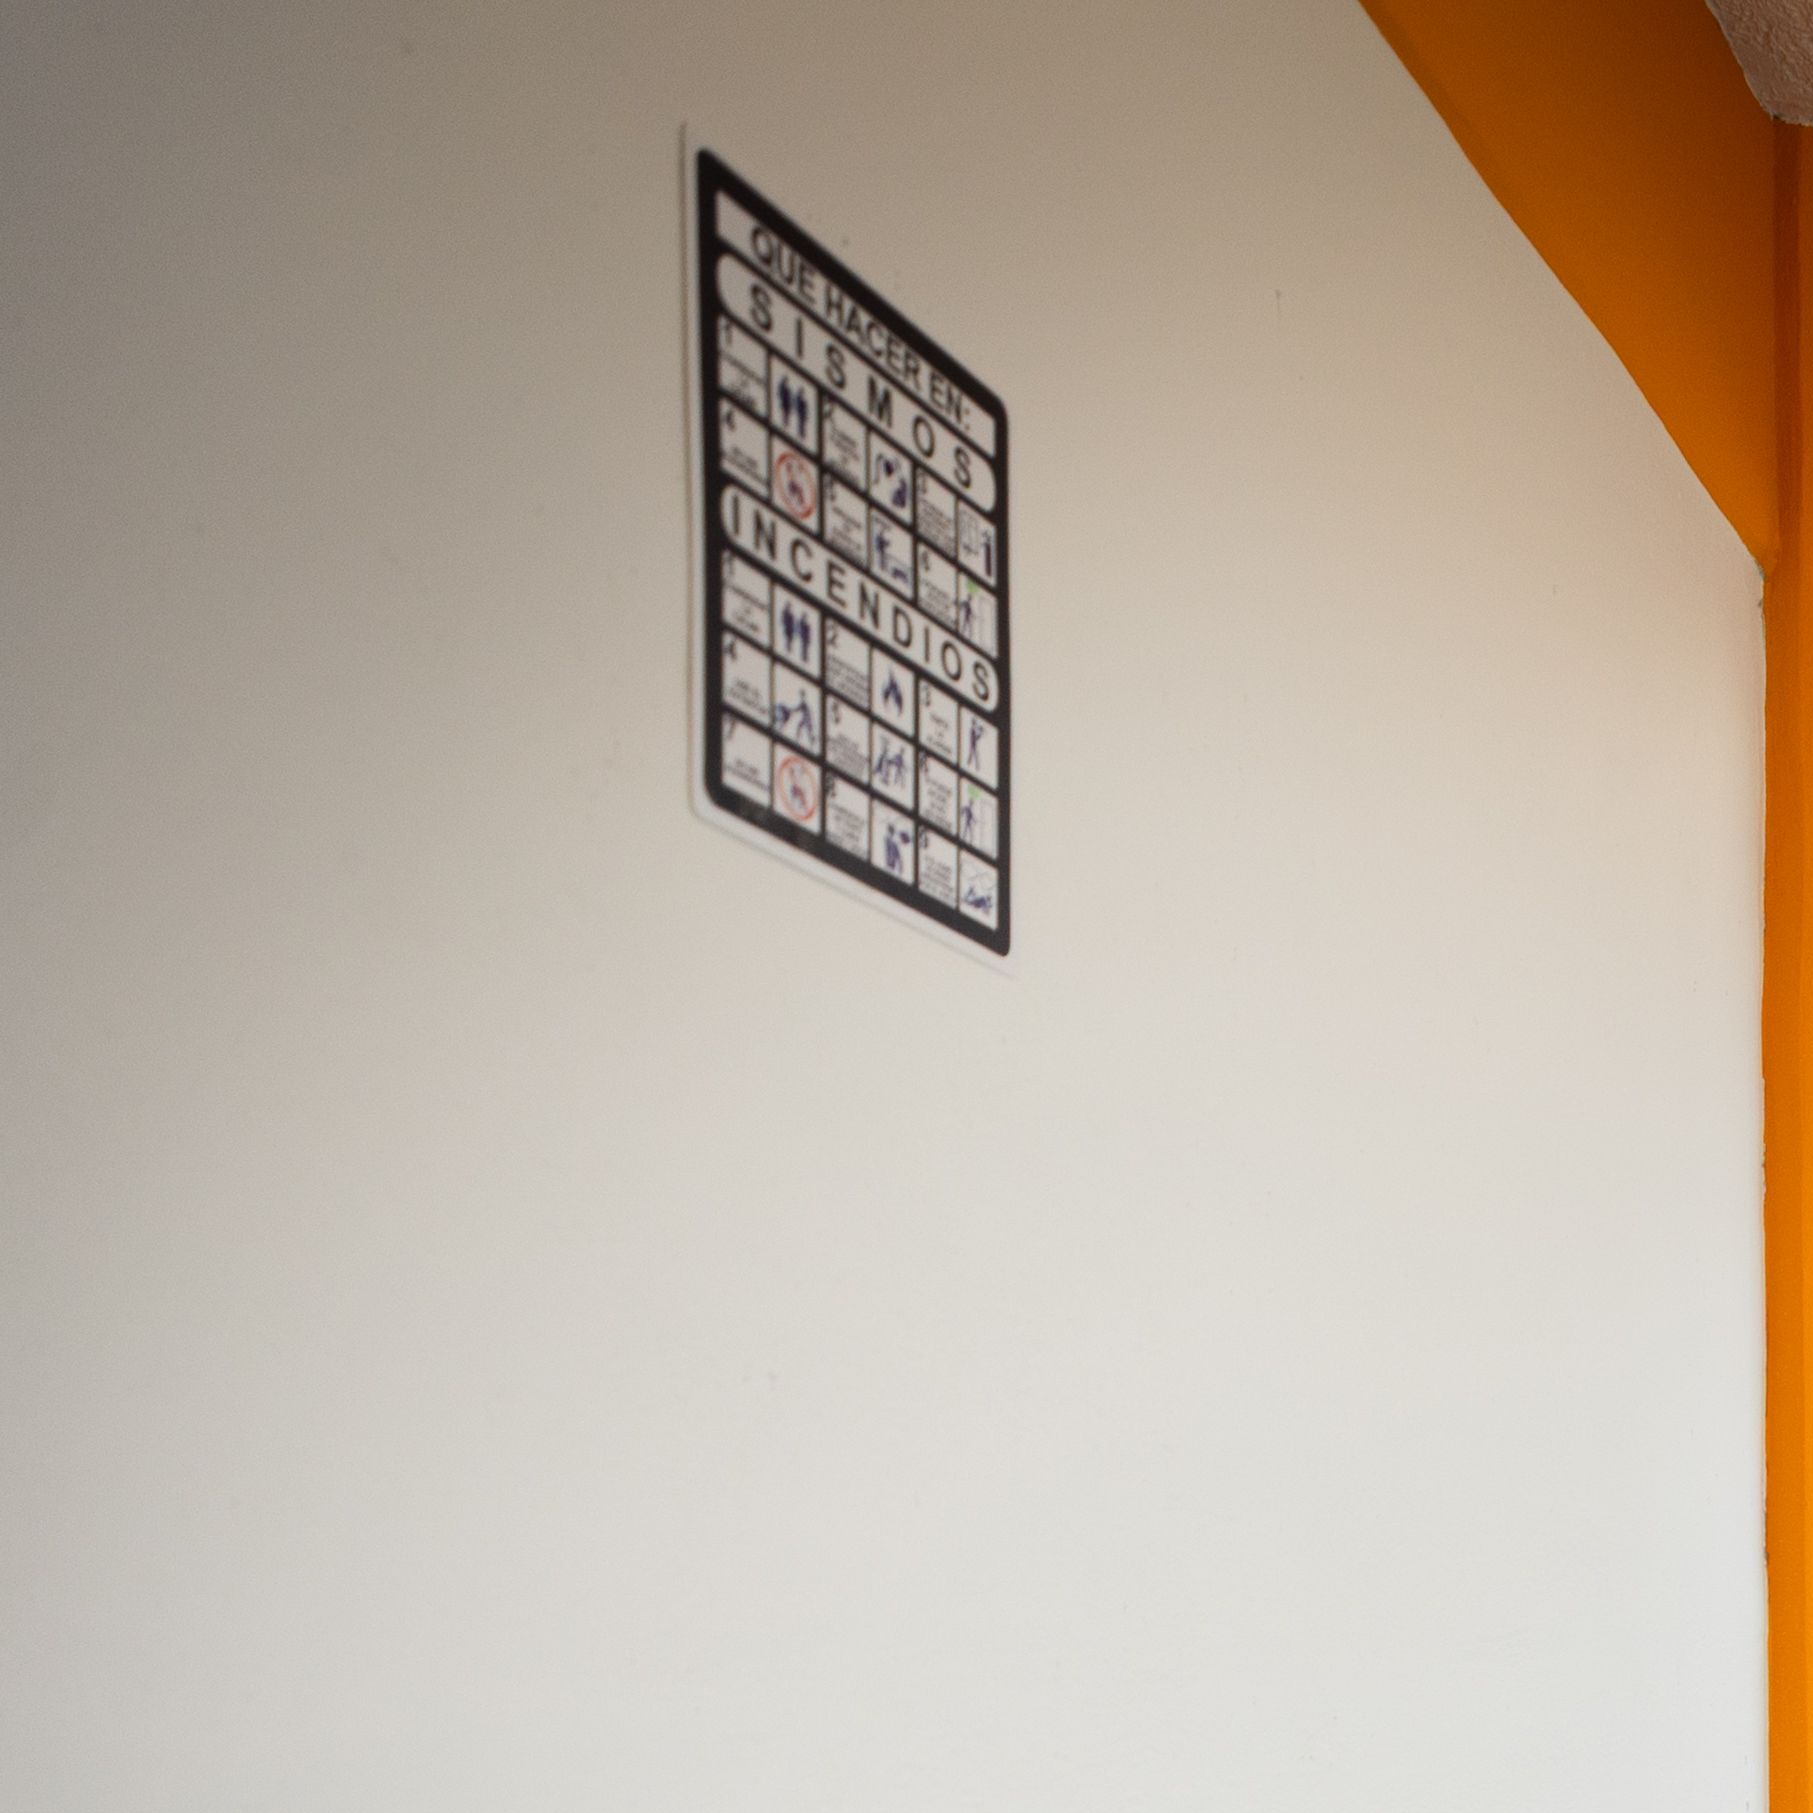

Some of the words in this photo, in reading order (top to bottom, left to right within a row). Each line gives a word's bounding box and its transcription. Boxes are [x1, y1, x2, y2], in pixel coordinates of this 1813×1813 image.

[751, 284, 970, 489] SISMOS
[824, 281, 921, 391] HACER
[732, 495, 989, 701] INCENDIOS
